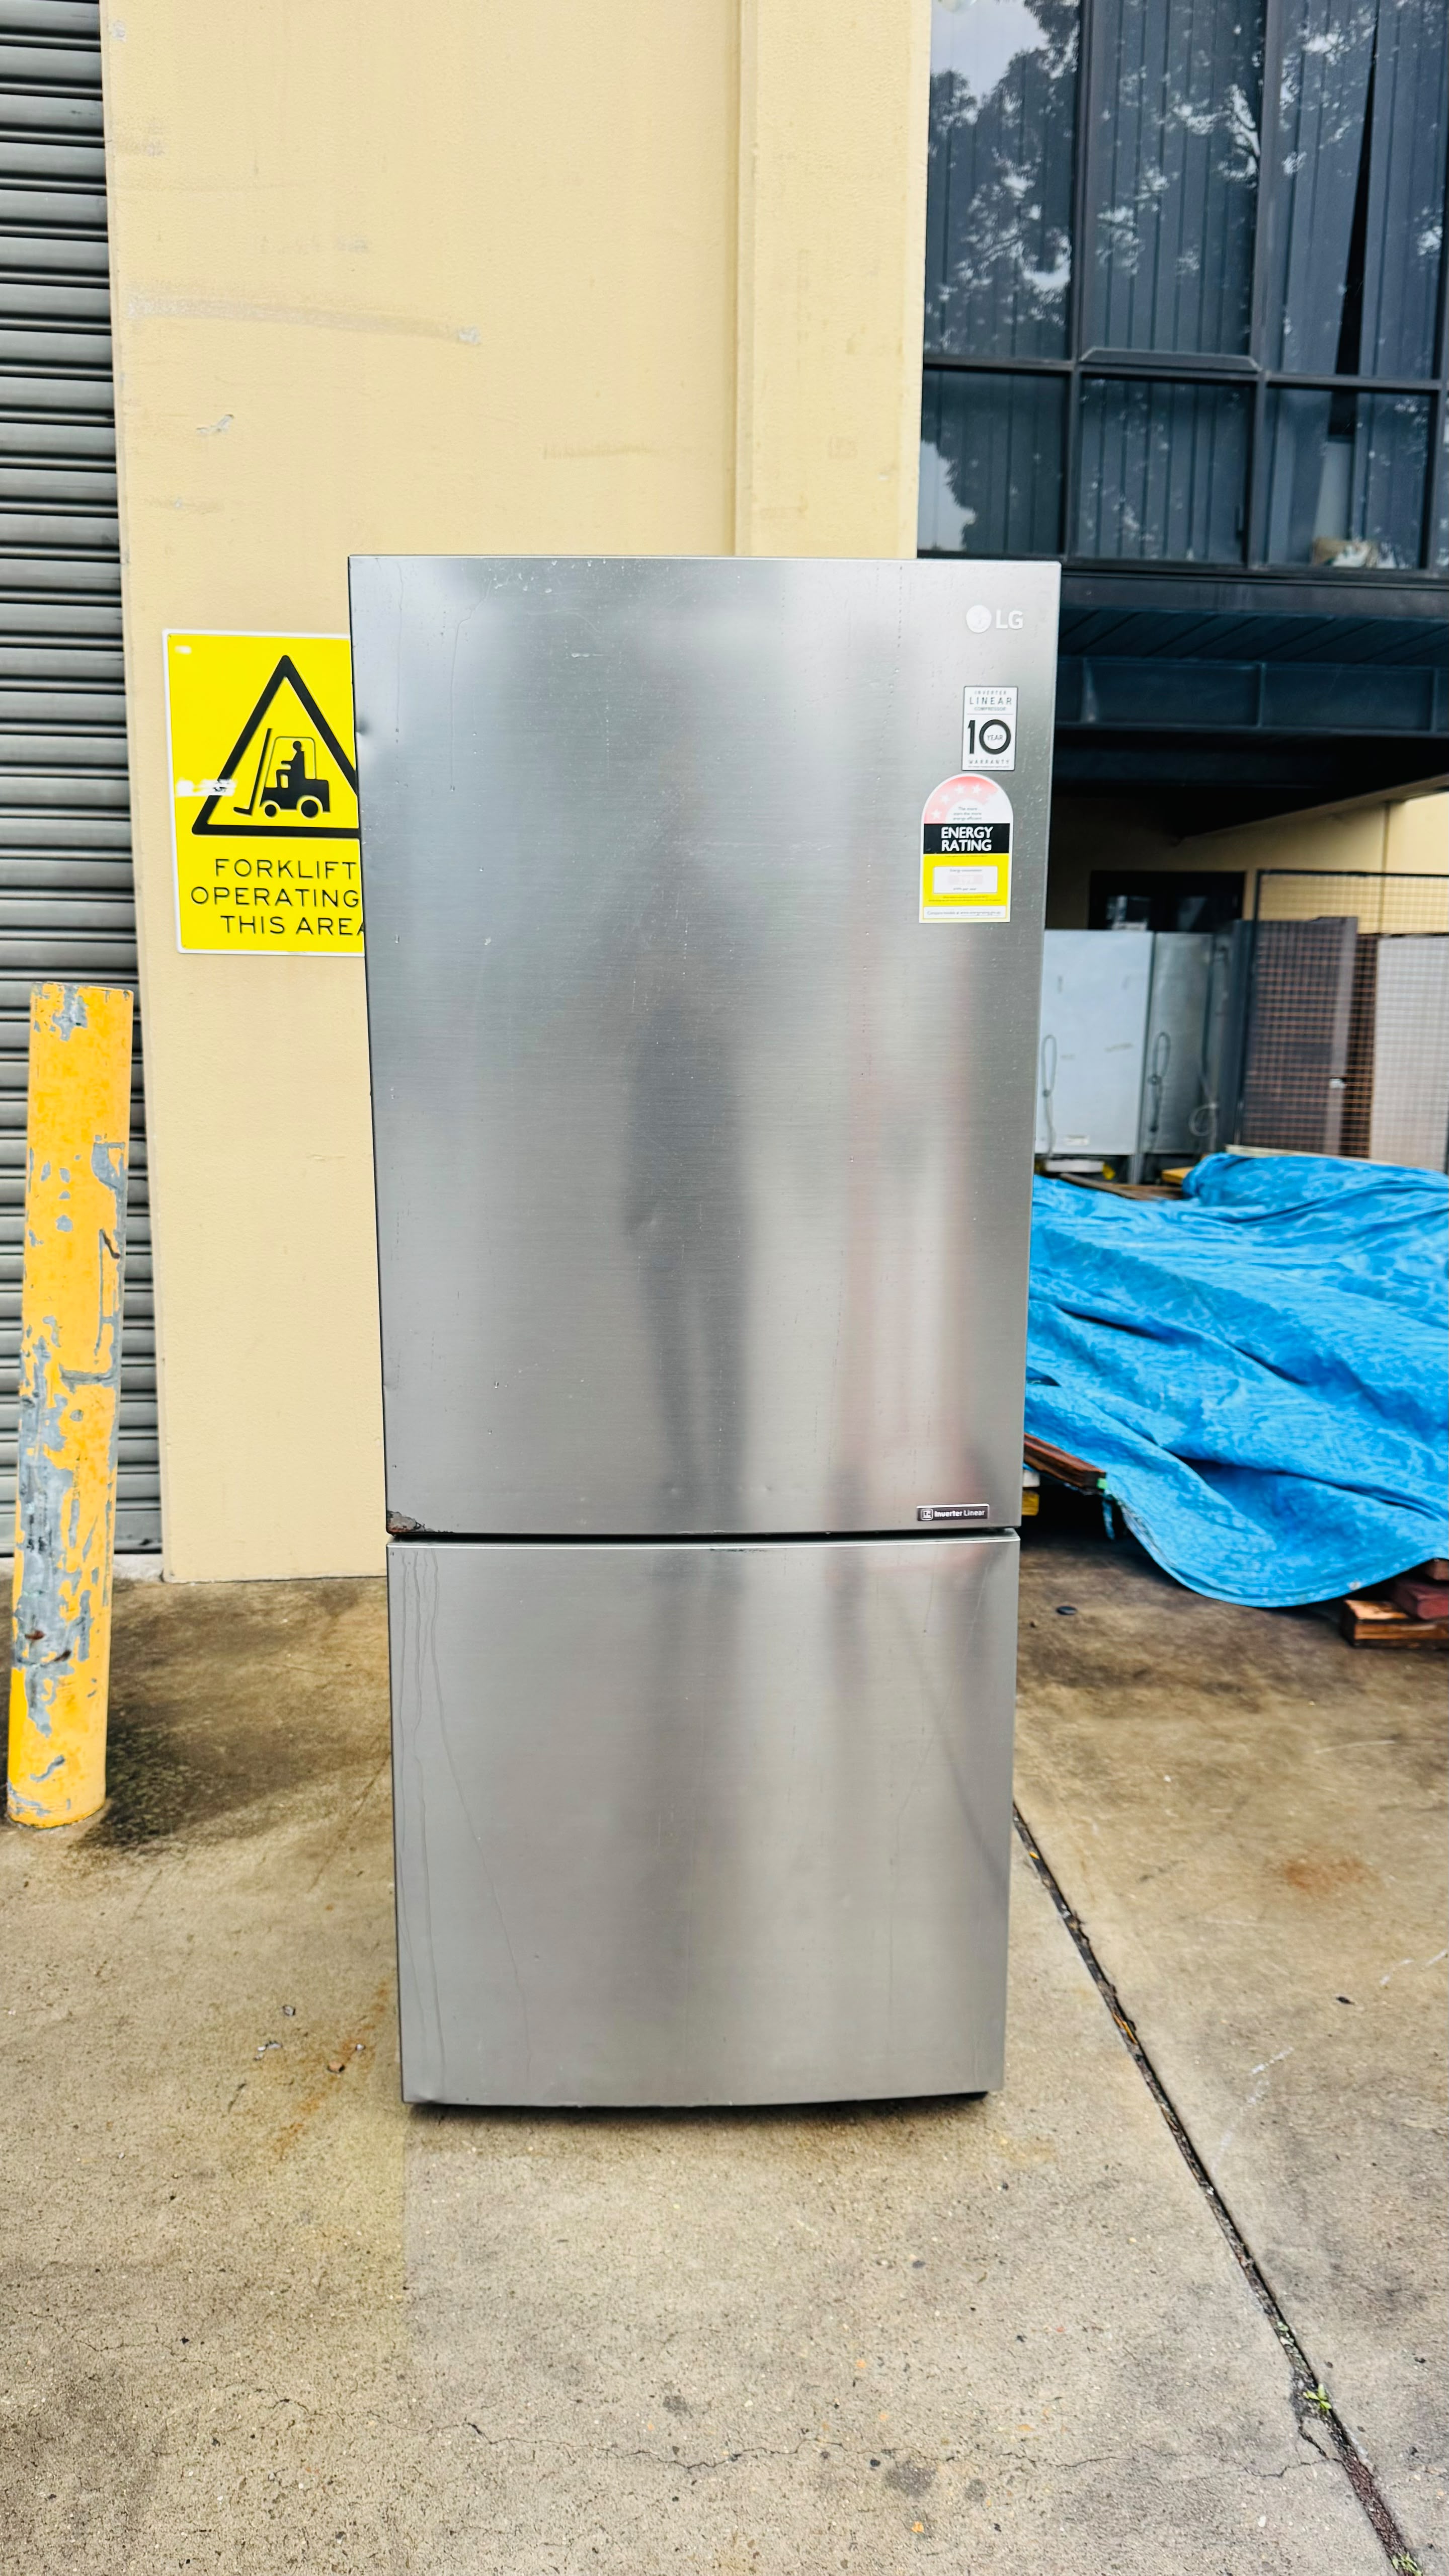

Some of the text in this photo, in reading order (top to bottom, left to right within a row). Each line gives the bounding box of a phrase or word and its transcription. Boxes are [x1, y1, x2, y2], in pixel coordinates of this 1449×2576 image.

[996, 609, 1023, 629] LG
[969, 697, 1012, 705] LINEAR
[968, 719, 1011, 755] 10
[941, 826, 993, 839] ENERGY
[941, 839, 992, 851] RATING
[215, 858, 356, 879] FORKLIFT
[191, 886, 359, 908] OPERATING
[220, 915, 285, 934] THIS
